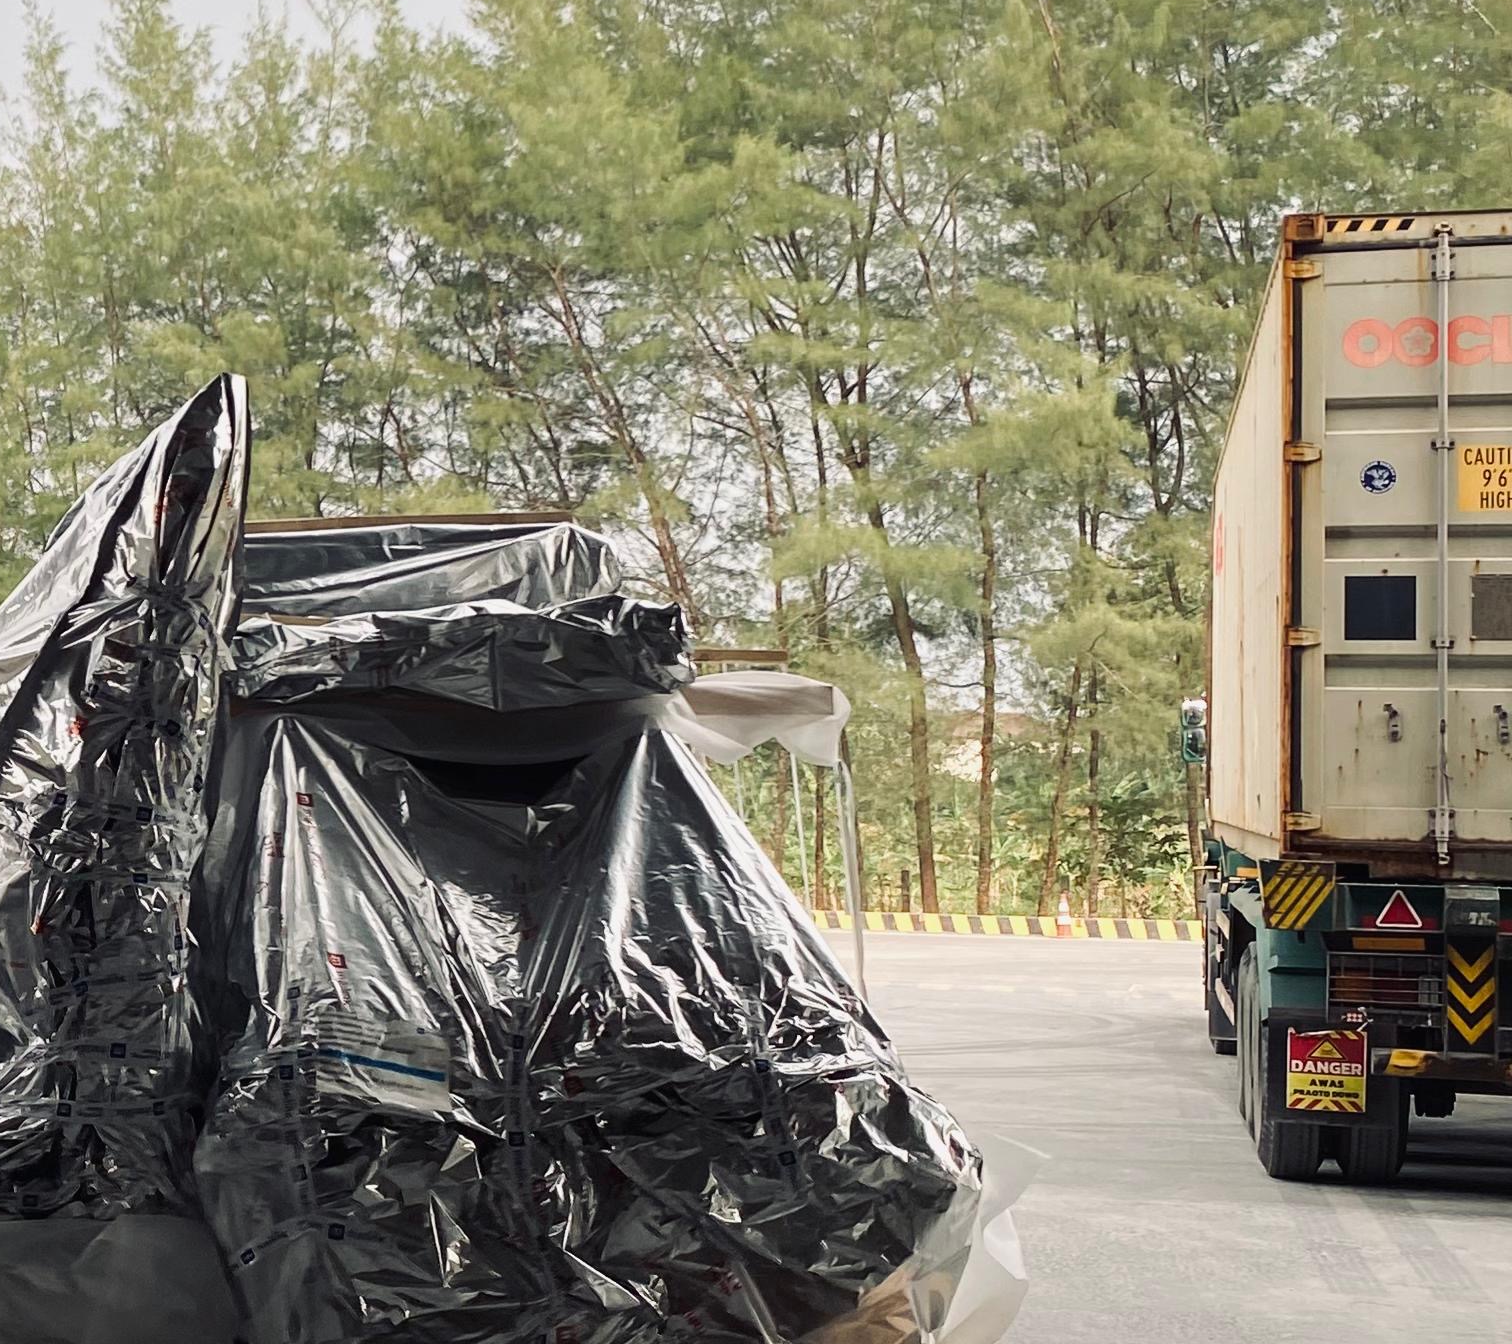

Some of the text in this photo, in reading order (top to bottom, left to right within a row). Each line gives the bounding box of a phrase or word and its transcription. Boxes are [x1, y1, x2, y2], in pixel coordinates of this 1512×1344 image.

[1464, 447, 1511, 466] CAUTI
[1291, 1060, 1362, 1075] DANGER
[1309, 1079, 1344, 1088] AWAS
